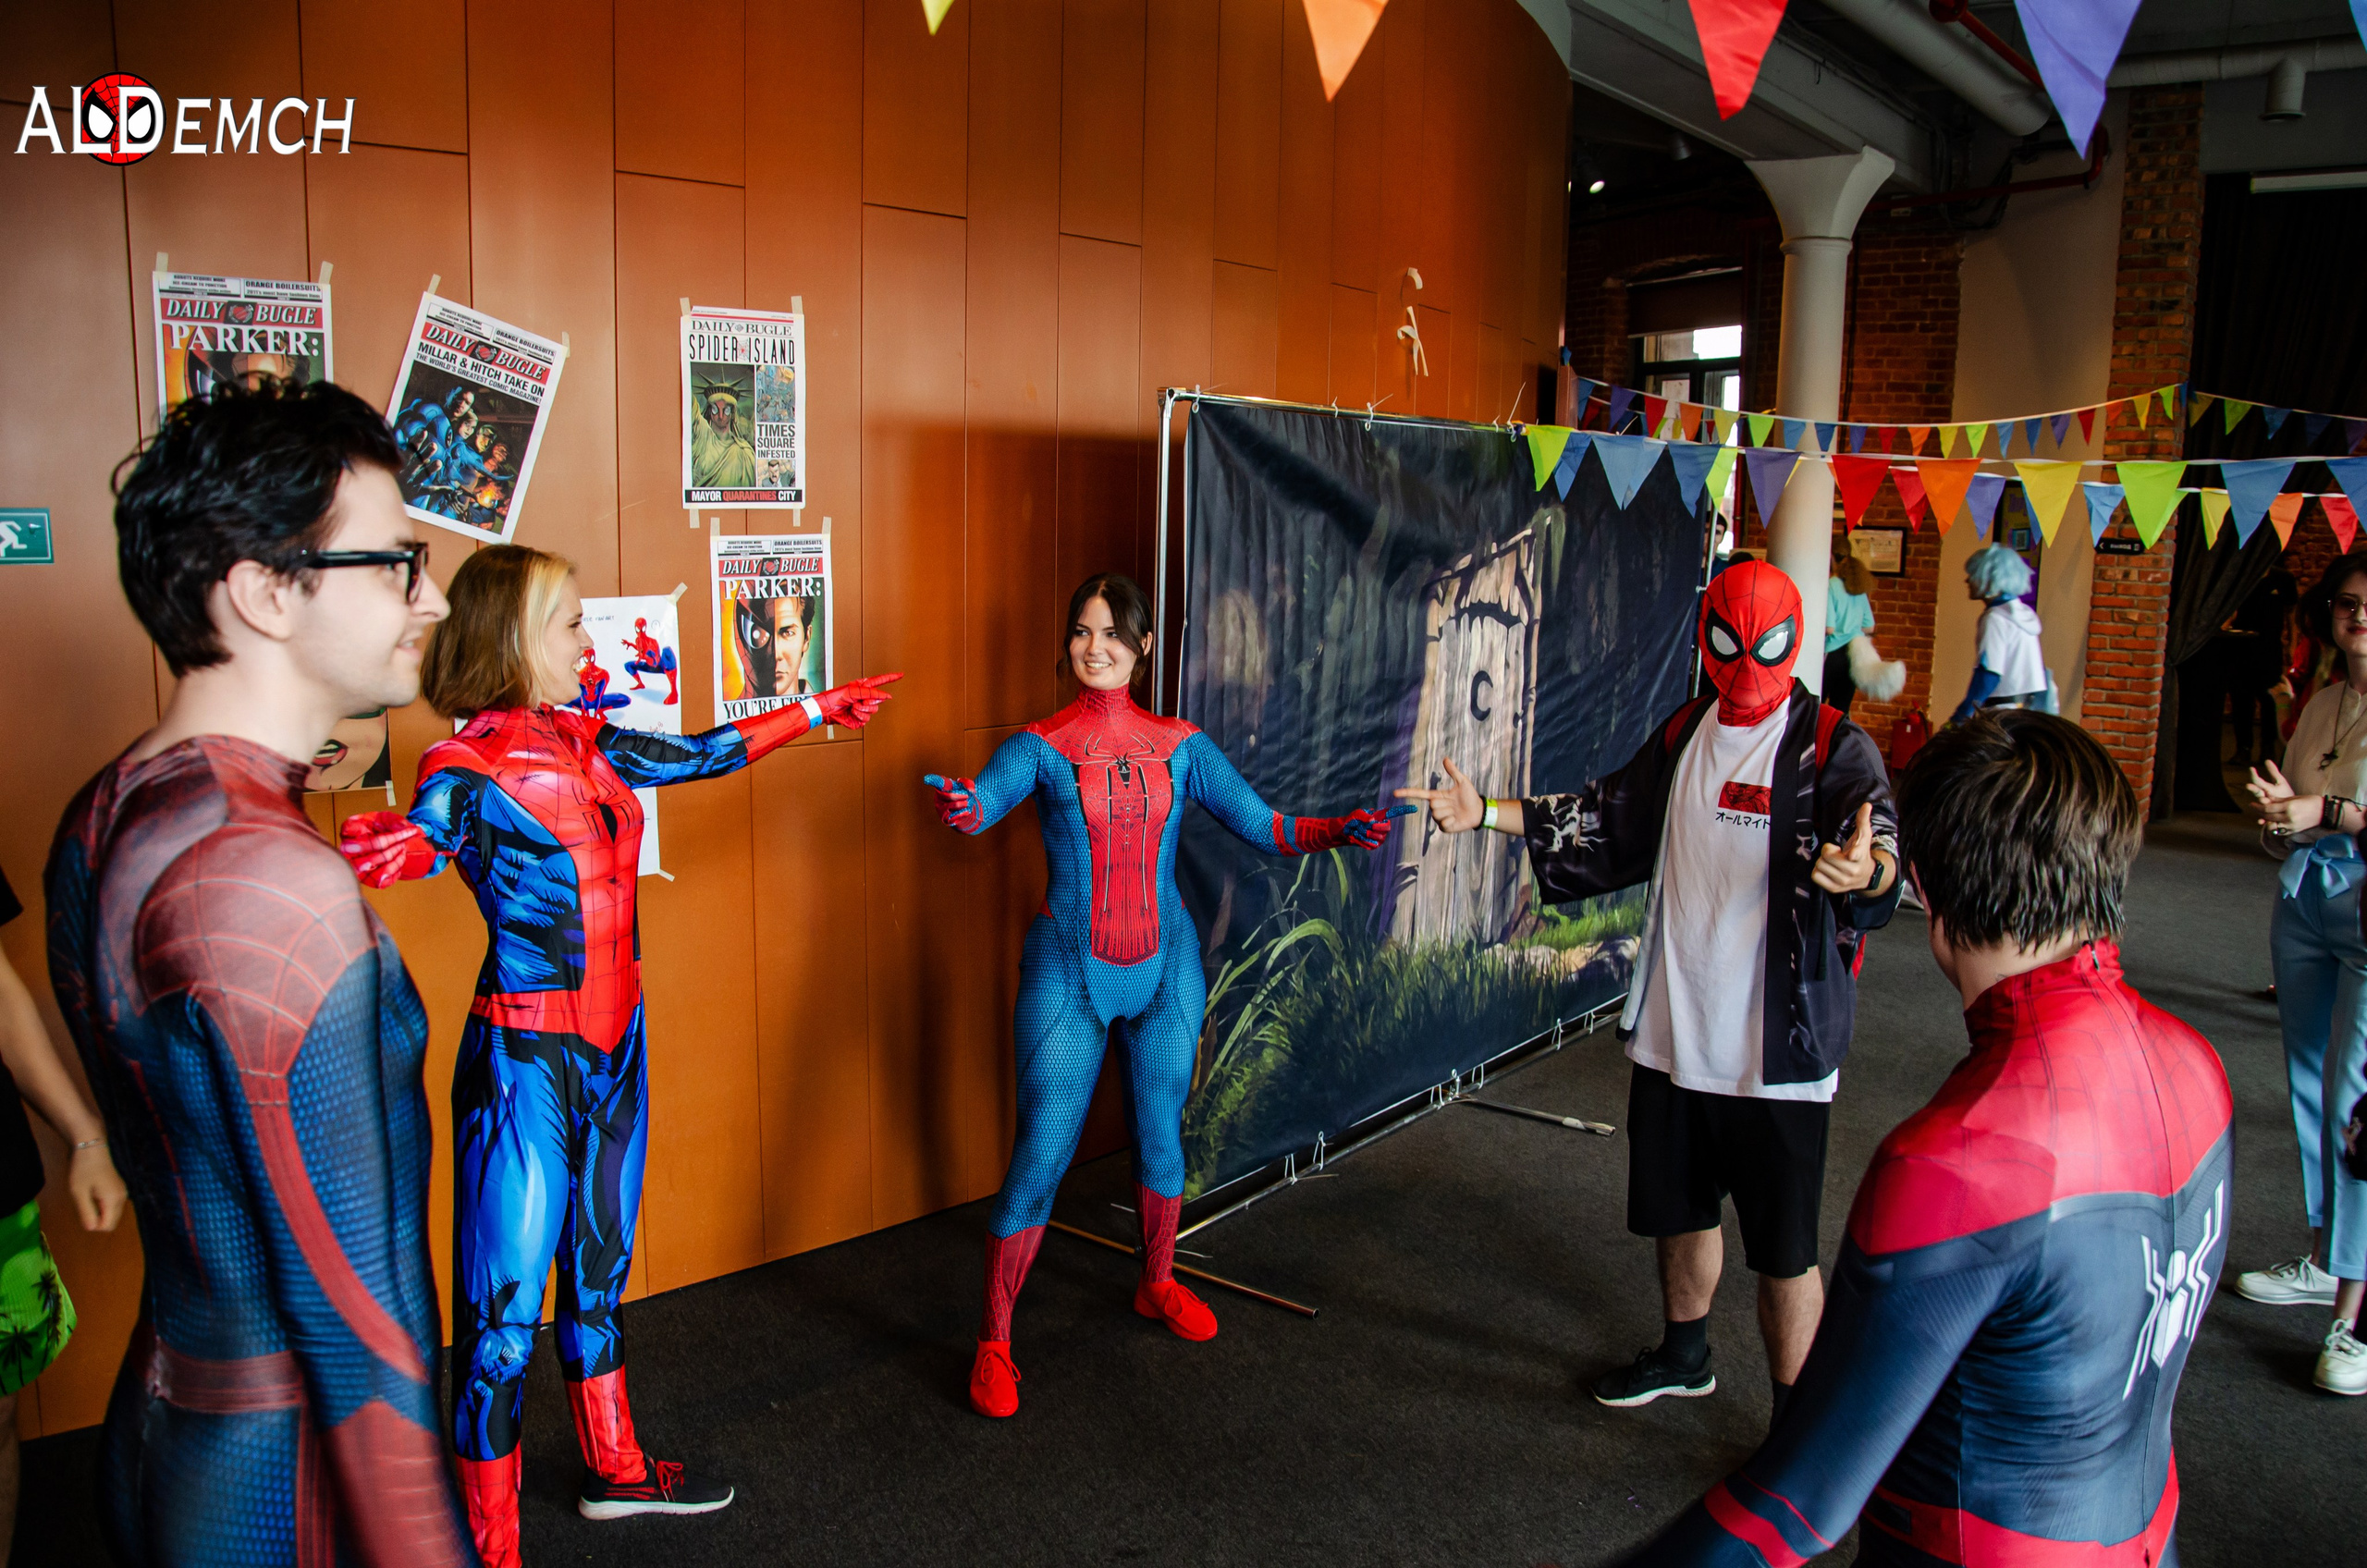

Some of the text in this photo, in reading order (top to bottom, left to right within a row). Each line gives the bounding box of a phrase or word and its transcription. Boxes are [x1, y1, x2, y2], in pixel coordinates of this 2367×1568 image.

[276, 283, 321, 291] BOILERSUITS
[166, 300, 316, 324] DAILY BUGLE
[692, 320, 792, 336] DAILY BUGLE
[170, 324, 319, 357] PARKER:
[497, 330, 555, 356] ORANGE BOILERSUITS
[689, 334, 795, 364] SPIDER ISLAND
[425, 325, 474, 351] DAILY
[496, 351, 546, 380] BUGLE
[416, 352, 541, 404] THE WORLD'S GREATEST COMIC MAGAZINE!
[418, 342, 545, 397] MILLAR & HITCH TAKE ON
[757, 423, 795, 437] TIMES
[757, 437, 795, 449] SQUARE
[757, 449, 795, 459] INFESTED
[692, 491, 796, 501] MAYOR QUARANTINES CITY
[722, 557, 819, 575] DAILY BUGLE
[724, 577, 821, 600] PARKER:
[724, 699, 777, 718] YOU'RE
[1716, 812, 1771, 829] オールマイト
